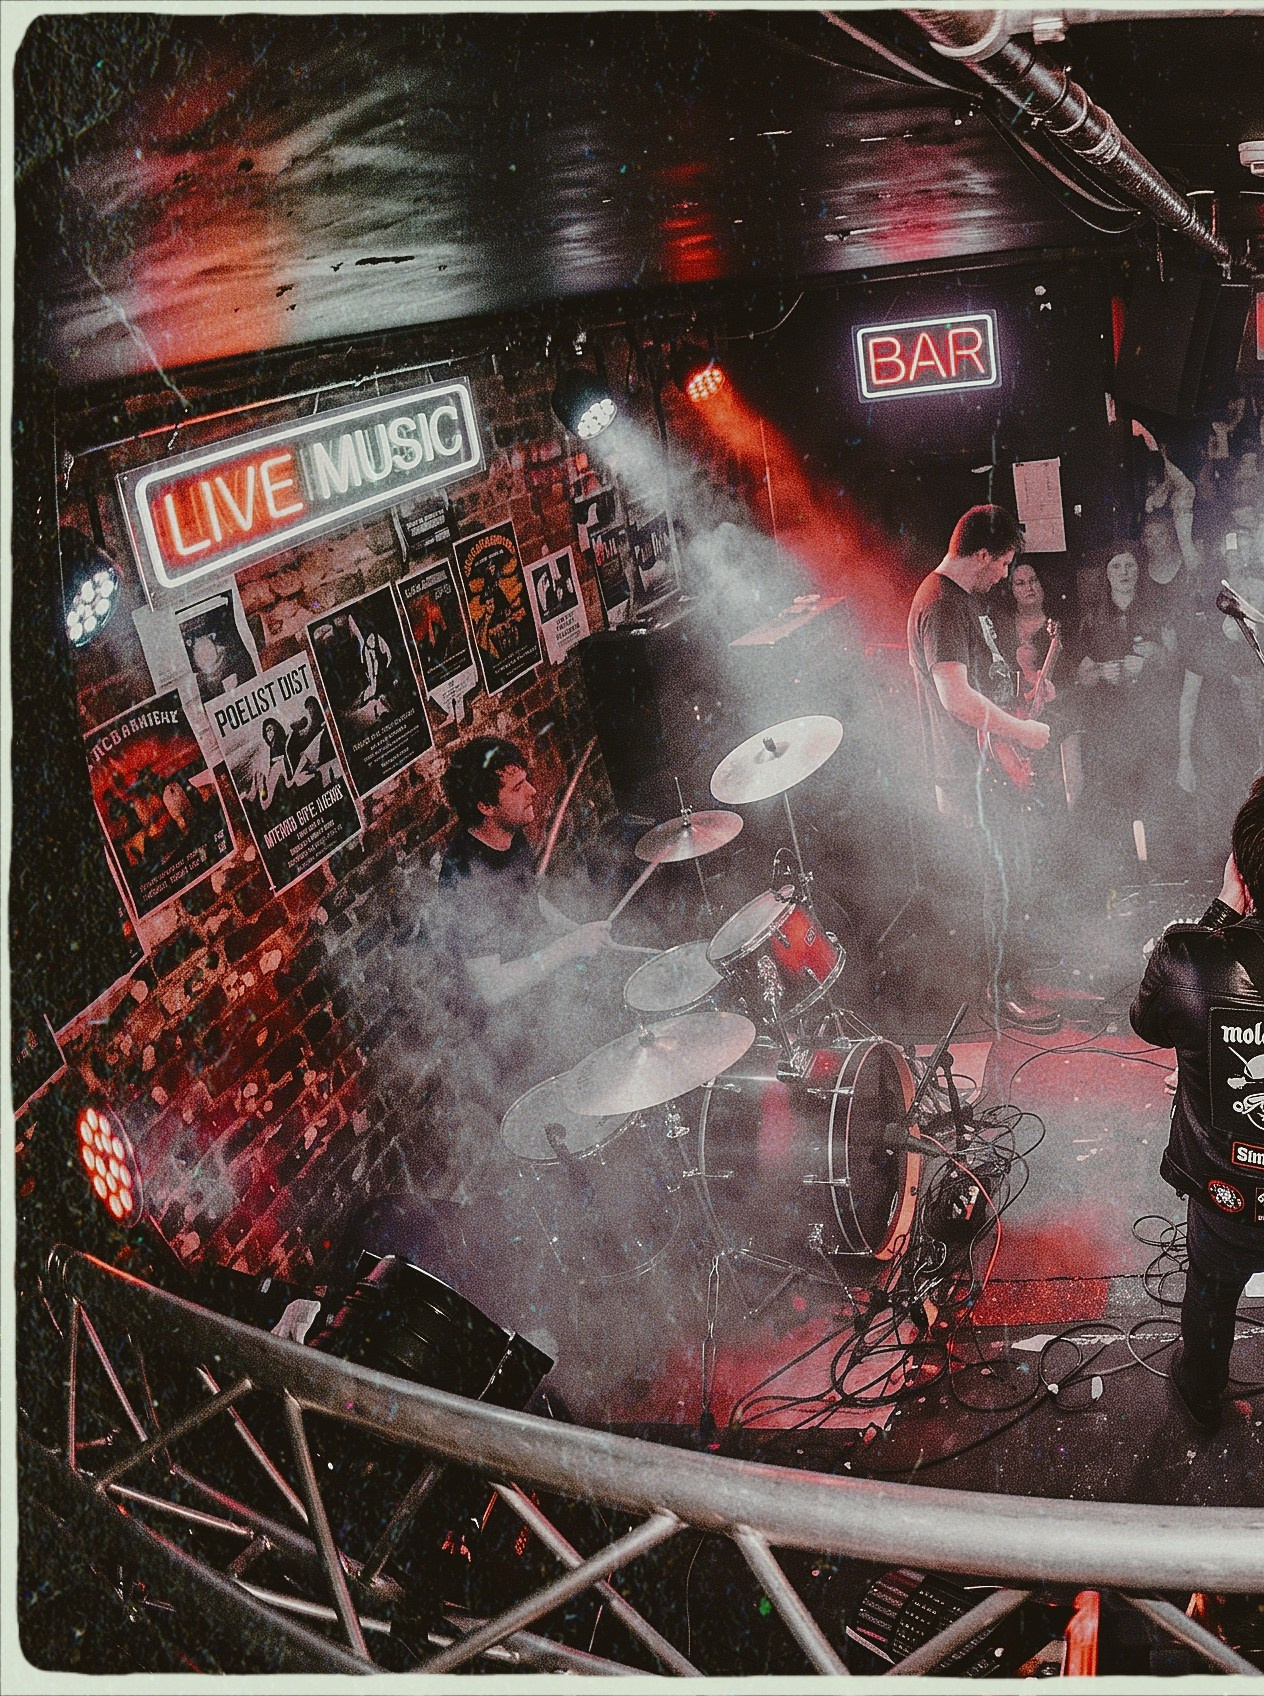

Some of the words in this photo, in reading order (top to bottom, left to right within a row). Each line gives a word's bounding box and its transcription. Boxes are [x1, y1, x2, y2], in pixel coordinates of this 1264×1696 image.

[868, 327, 985, 386] BAR
[164, 453, 304, 556] LIVE
[313, 405, 463, 500] MUSIC
[214, 681, 277, 738] POELIST
